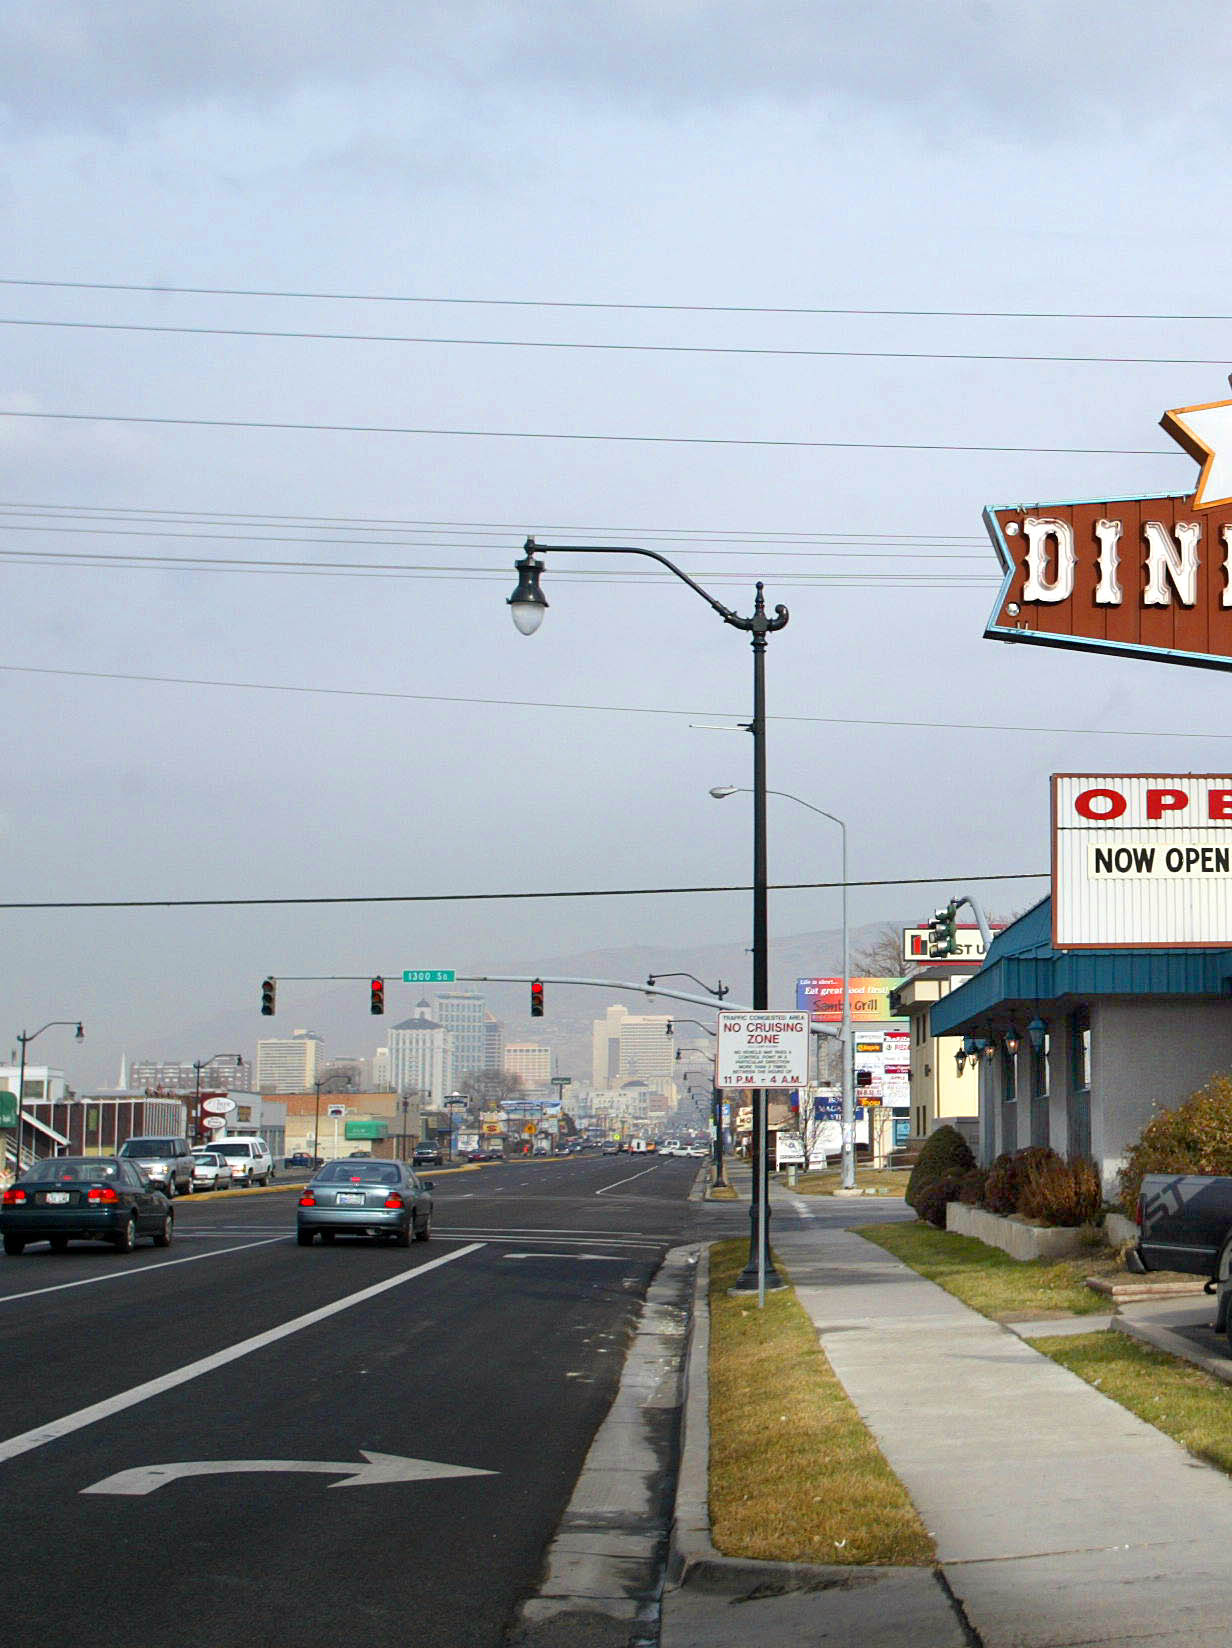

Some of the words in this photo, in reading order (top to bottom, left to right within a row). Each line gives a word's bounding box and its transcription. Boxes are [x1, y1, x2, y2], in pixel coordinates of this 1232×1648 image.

[1095, 847, 1155, 873] NOW
[1166, 847, 1229, 873] OPEN
[804, 986, 818, 995] Eat
[821, 987, 844, 996] great
[848, 986, 865, 994] ood
[854, 999, 878, 1011] Grill
[723, 1022, 741, 1033] NO
[746, 1022, 804, 1033] CRUISING
[746, 1034, 781, 1044] ZONE
[724, 1075, 732, 1084] 11
[769, 1075, 777, 1084] 4
